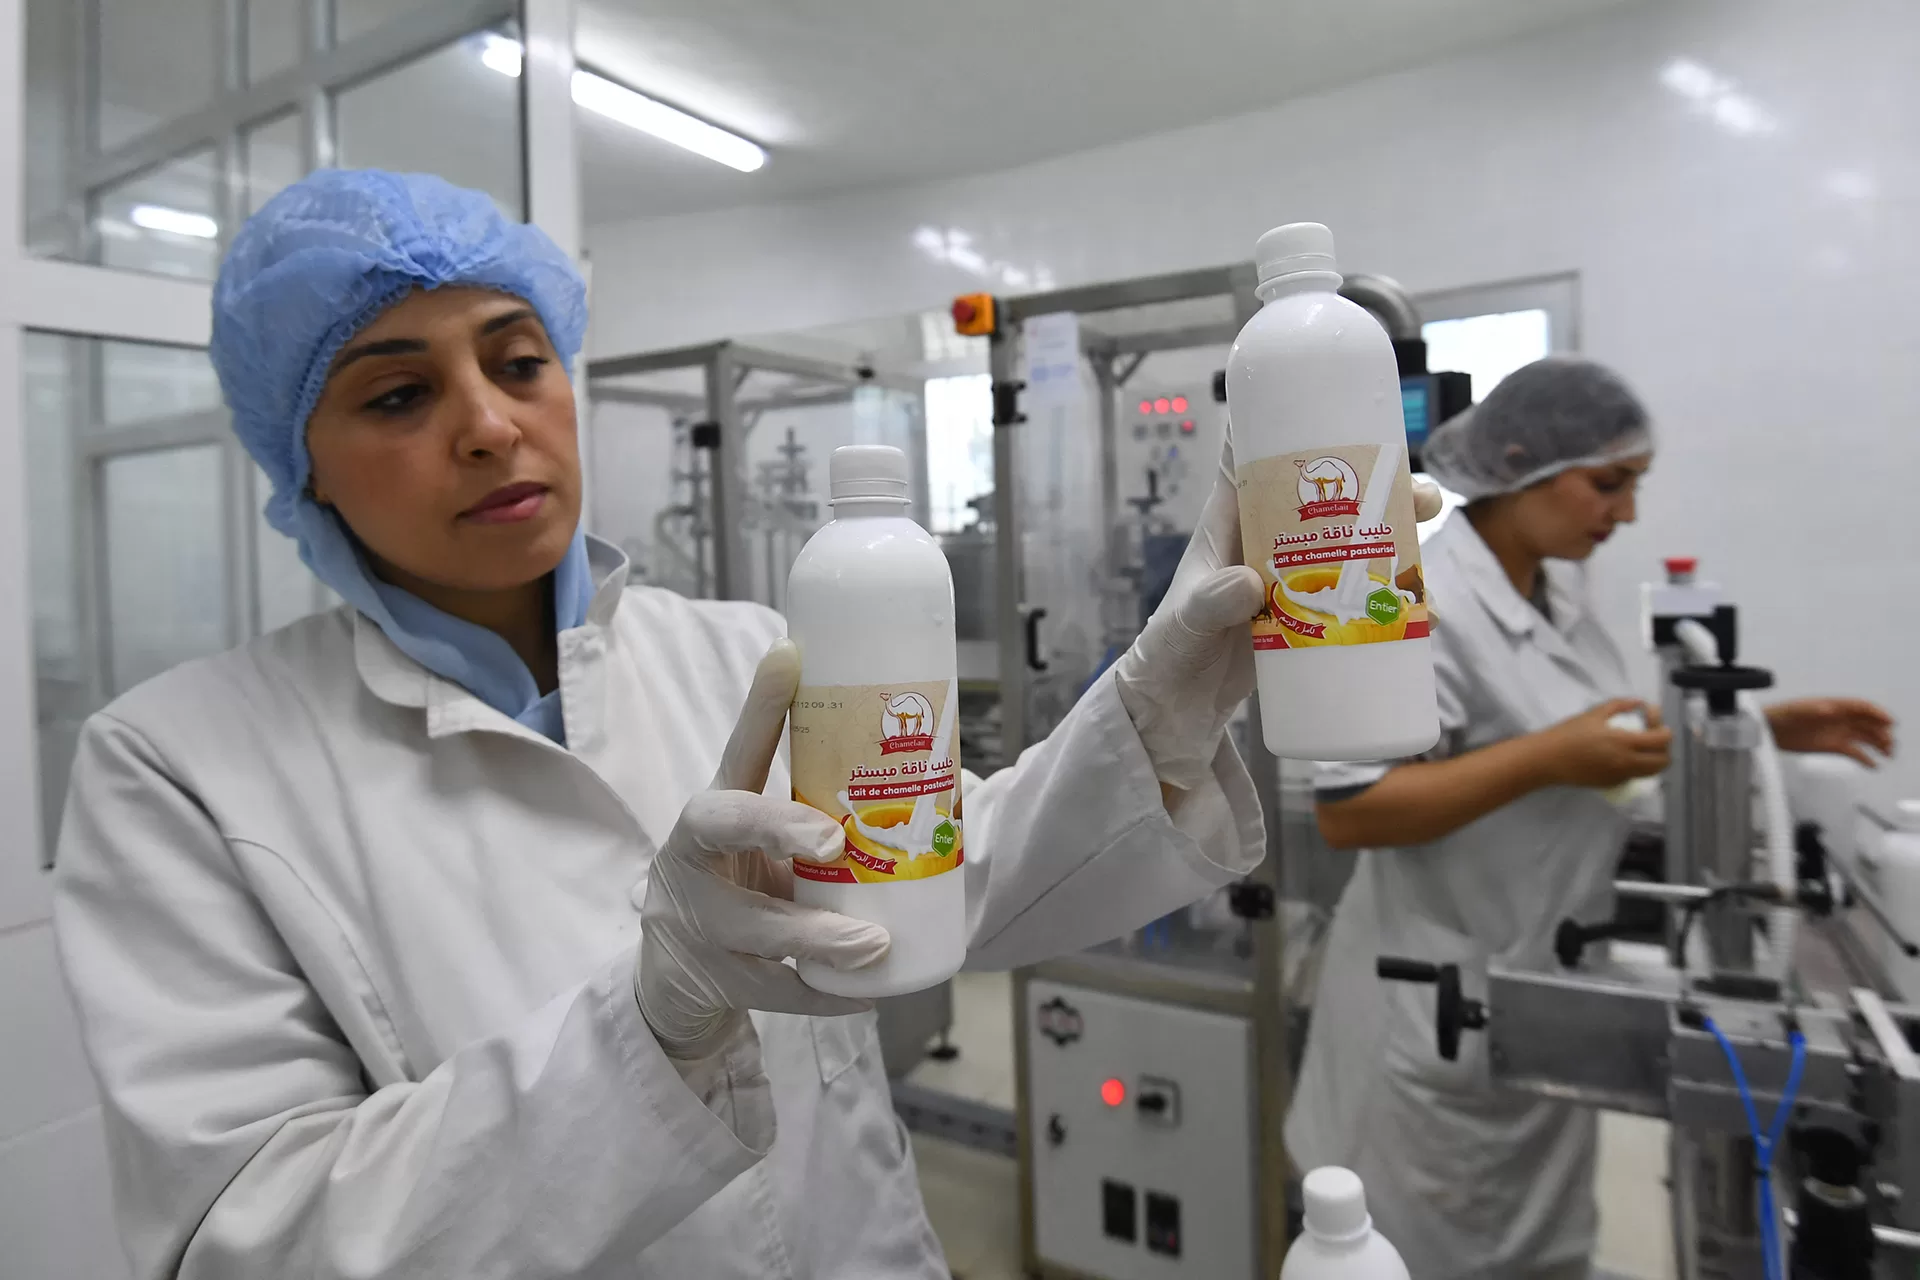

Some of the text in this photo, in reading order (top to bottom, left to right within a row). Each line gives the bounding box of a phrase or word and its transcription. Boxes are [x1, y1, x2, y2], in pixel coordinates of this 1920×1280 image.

[1273, 522, 1393, 550] حليب ناقة مبستر
[1274, 545, 1394, 565] Lait de chamelle pasteurisé
[1370, 600, 1398, 613] Entier
[849, 757, 953, 781] حليب ناقة مبستر
[849, 788, 867, 797] Lait
[869, 787, 881, 796] de
[883, 783, 922, 795] chamelle
[935, 833, 954, 844] Entier
